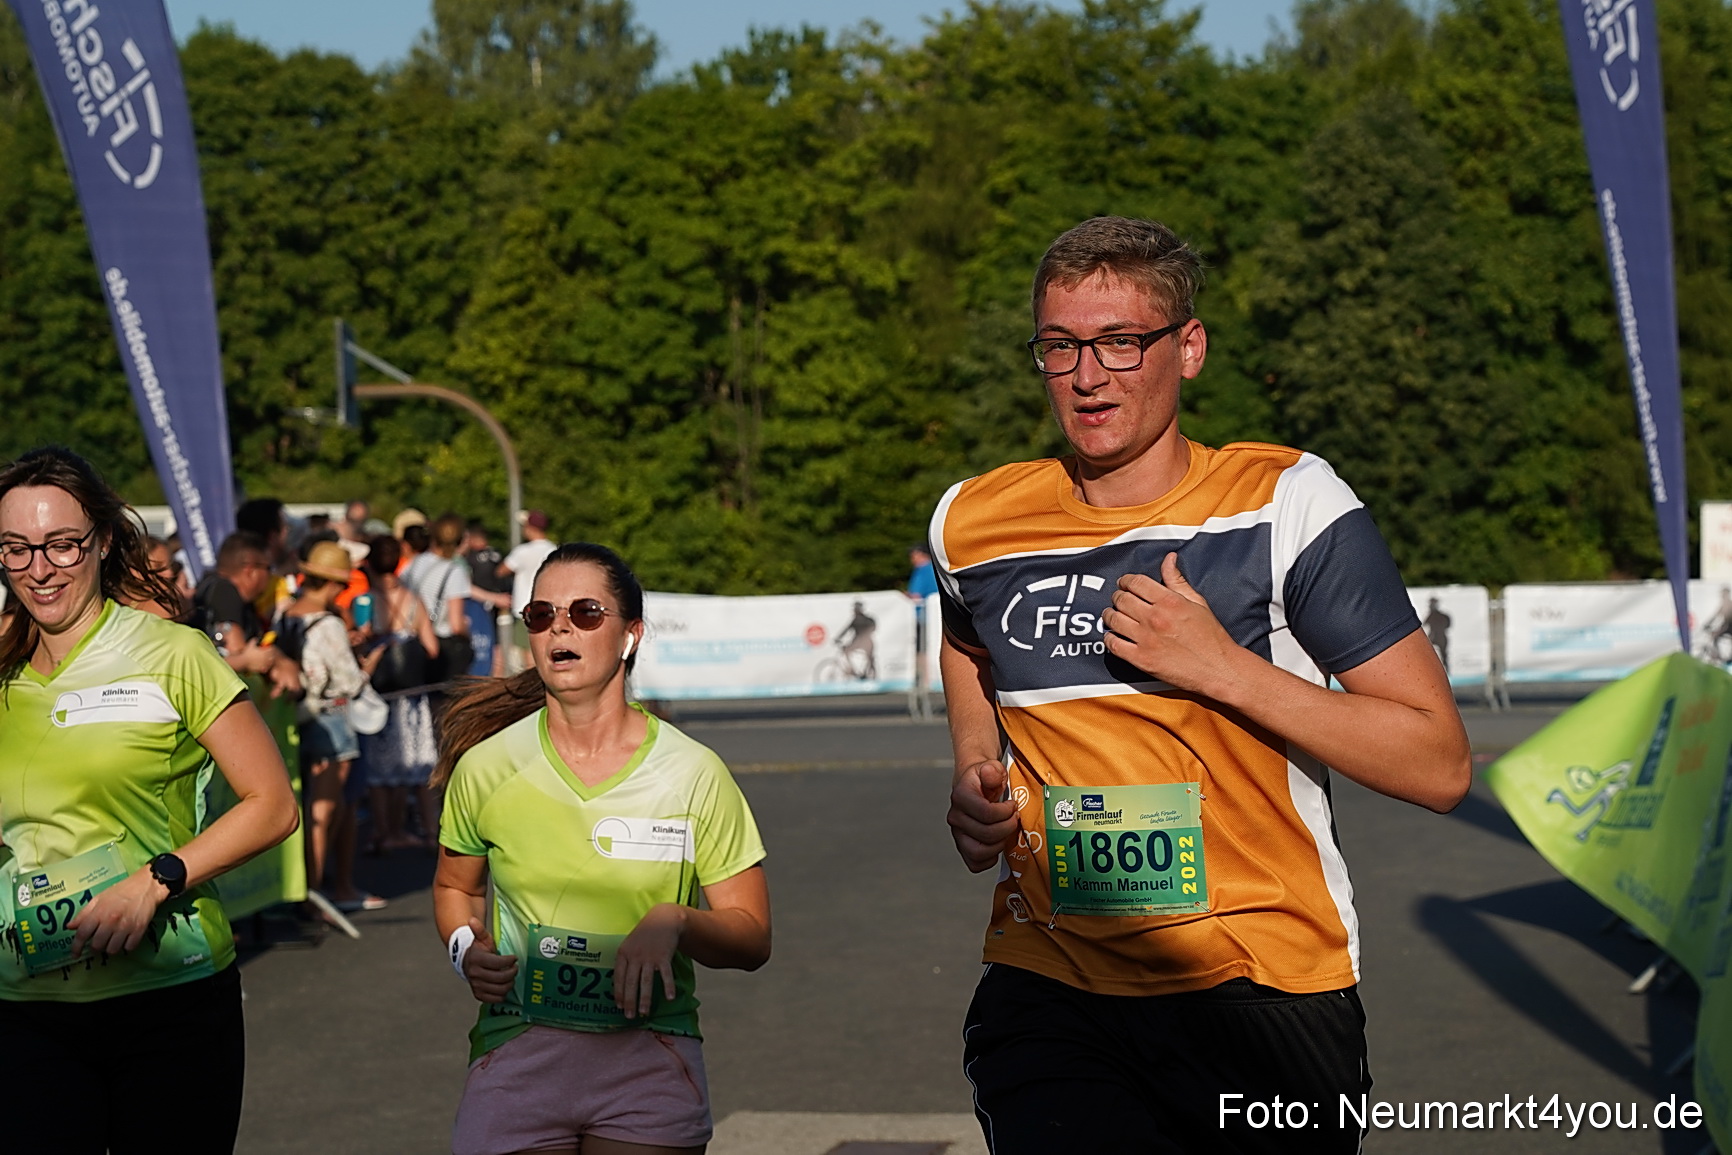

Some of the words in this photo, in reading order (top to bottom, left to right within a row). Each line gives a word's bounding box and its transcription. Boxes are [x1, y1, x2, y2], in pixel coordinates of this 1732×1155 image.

[1050, 642, 1109, 658] AUTO
[102, 688, 138, 696] Klinikum
[1077, 809, 1122, 820] Firmenlauf
[1094, 818, 1122, 826] neumarkt
[652, 826, 686, 835] Klinikum
[1068, 830, 1173, 873] 1860
[1054, 845, 1069, 888] RUN
[1178, 835, 1197, 895] 2022
[30, 880, 65, 898] Firmenlauf
[1074, 878, 1113, 891] Kamm
[1117, 877, 1174, 891] Manuel
[20, 920, 37, 955] RUN
[561, 948, 601, 958] Firmenlauf
[531, 969, 544, 1004] RUN
[544, 996, 589, 1013] Fanderl
